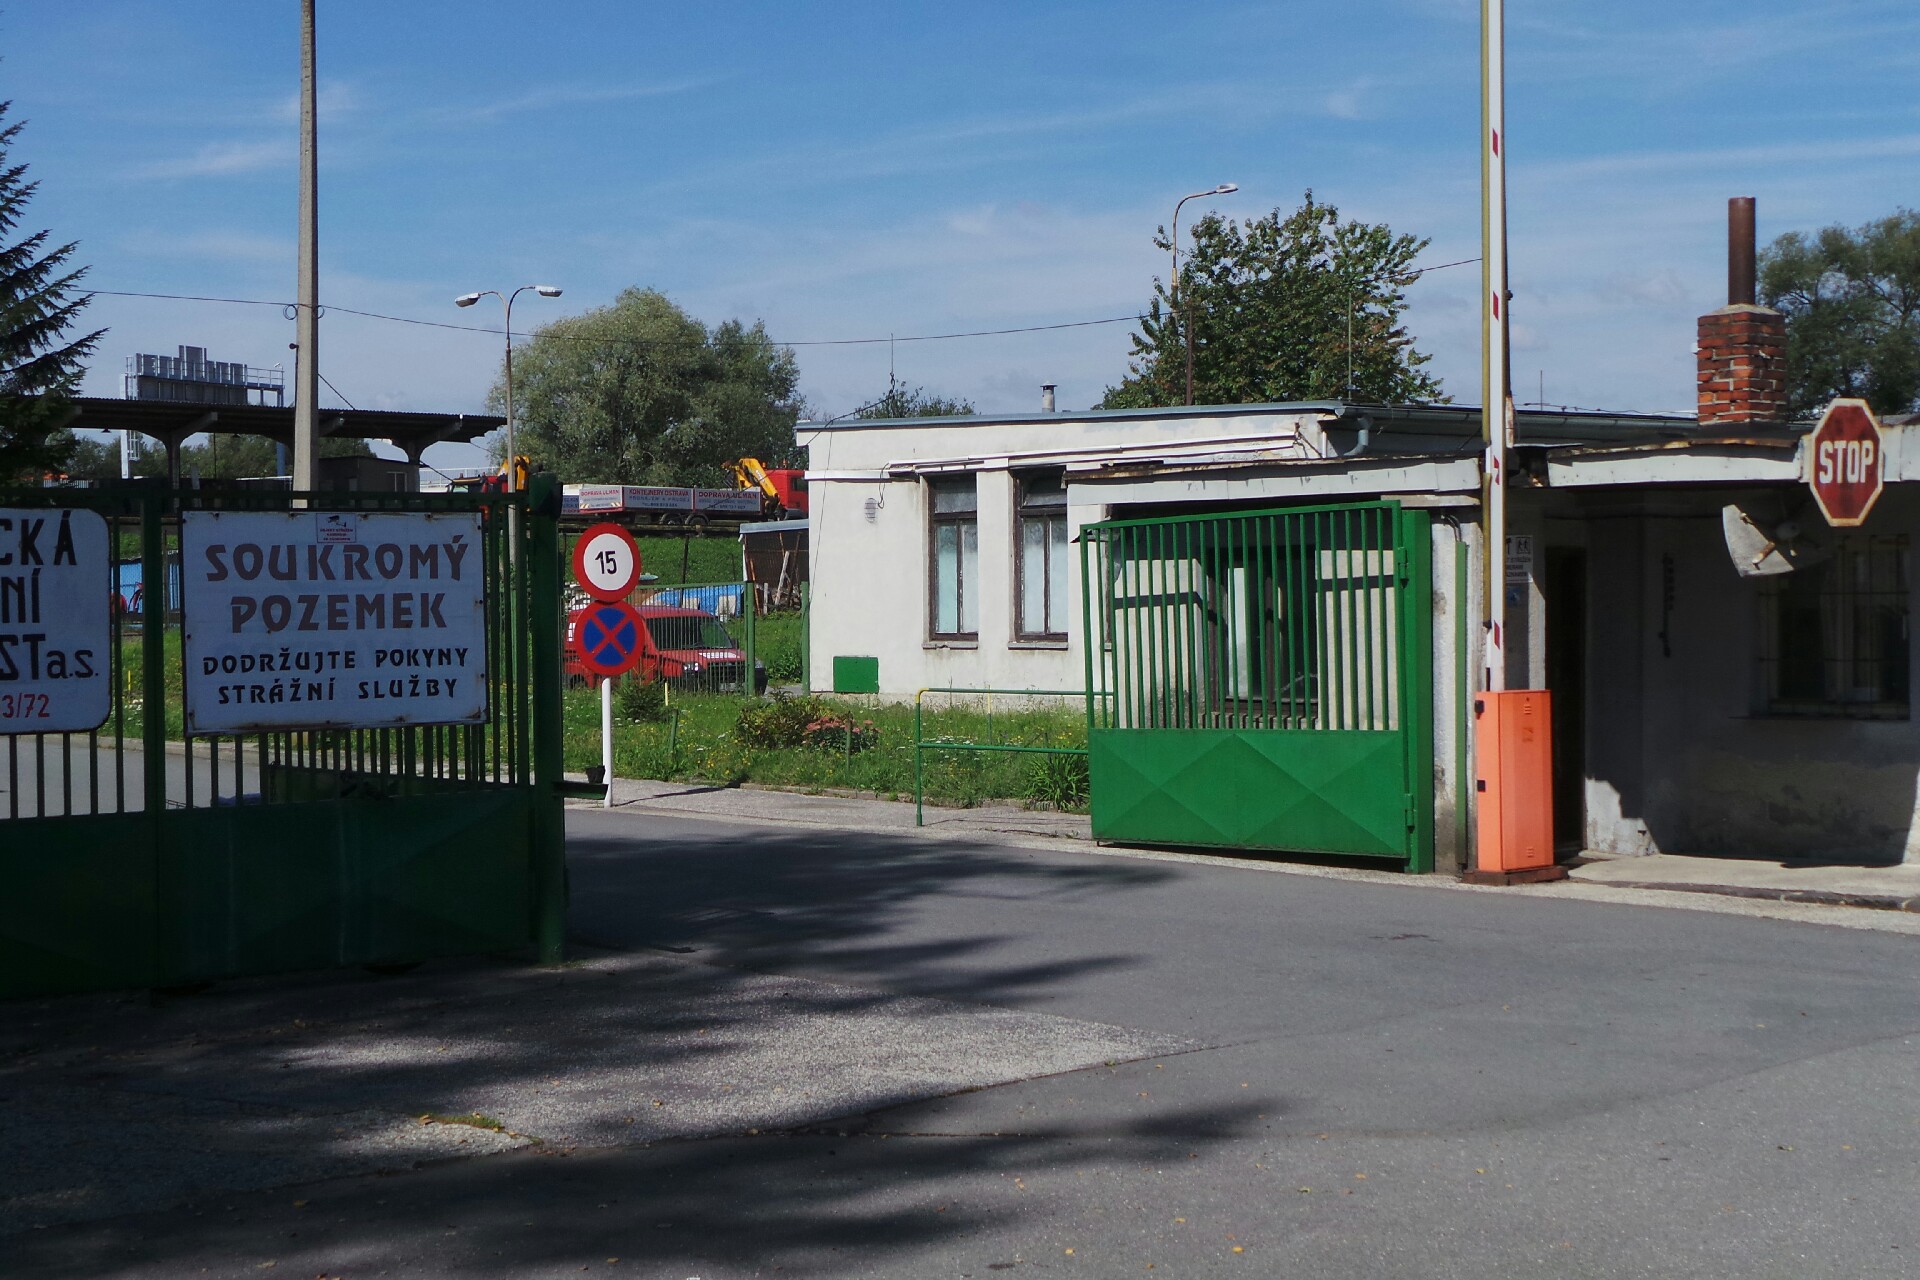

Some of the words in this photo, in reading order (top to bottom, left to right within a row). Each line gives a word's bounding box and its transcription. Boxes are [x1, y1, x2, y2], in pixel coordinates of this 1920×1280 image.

[1819, 440, 1874, 484] STOP
[629, 488, 664, 496] KONTEJNERY
[206, 534, 469, 582] SOUKROMÝ
[595, 551, 618, 575] 15
[231, 593, 448, 635] POZEMEK
[203, 648, 356, 676] DODRŽUJTE
[375, 647, 469, 669] POKYNY
[219, 677, 336, 705] STRÁŽNÍ
[359, 675, 458, 700] SLUŽBY
